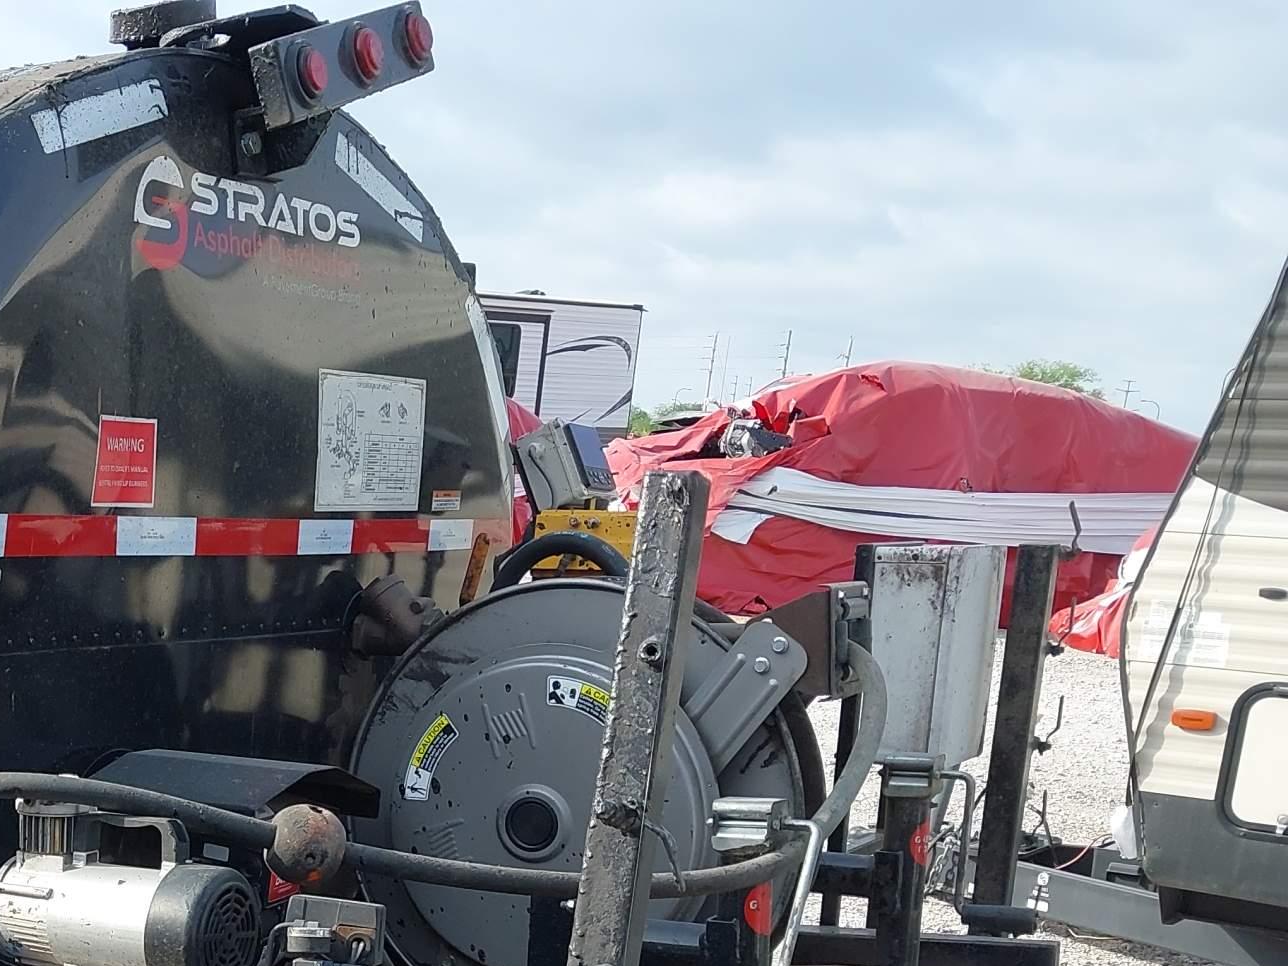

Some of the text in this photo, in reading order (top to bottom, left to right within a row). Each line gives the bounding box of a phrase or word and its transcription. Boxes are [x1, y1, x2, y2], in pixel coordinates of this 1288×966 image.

[190, 172, 361, 248] STRATOS
[193, 221, 262, 260] Asphalt
[106, 436, 145, 453] WARNING
[418, 720, 445, 755] CAUTION
